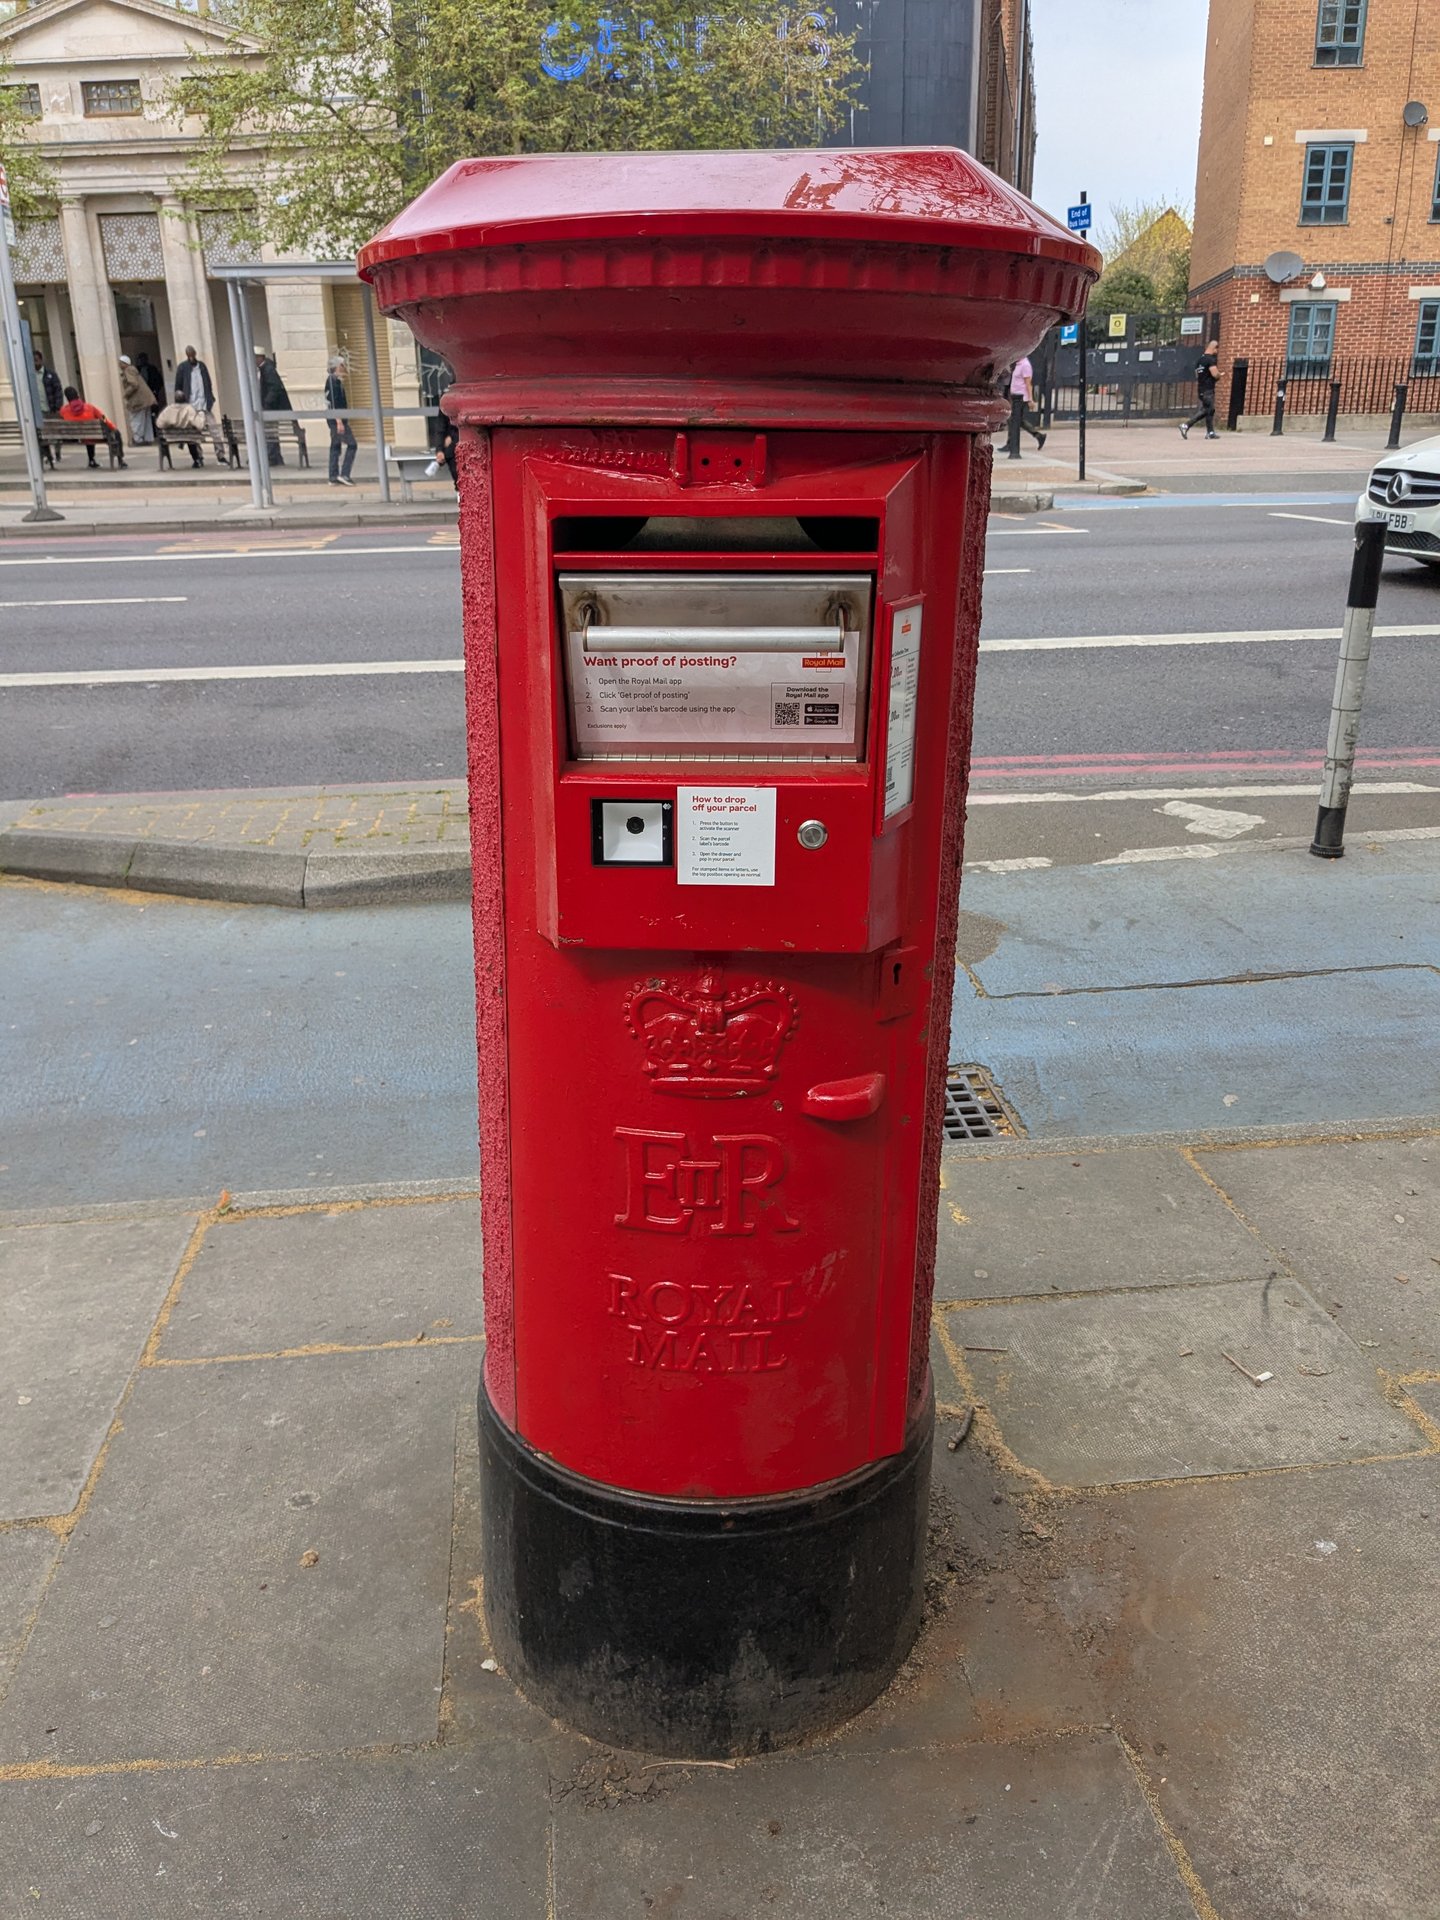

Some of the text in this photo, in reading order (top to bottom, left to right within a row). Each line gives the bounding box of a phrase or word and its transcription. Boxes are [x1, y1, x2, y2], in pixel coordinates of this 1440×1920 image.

[540, 11, 831, 81] GENES
[1071, 208, 1088, 218] End of
[1388, 513, 1408, 528] FBB
[583, 656, 736, 668] Want proof of posting?
[725, 796, 746, 804] drop
[607, 1272, 807, 1327] ROYAL
[626, 1323, 789, 1374] MAIL
